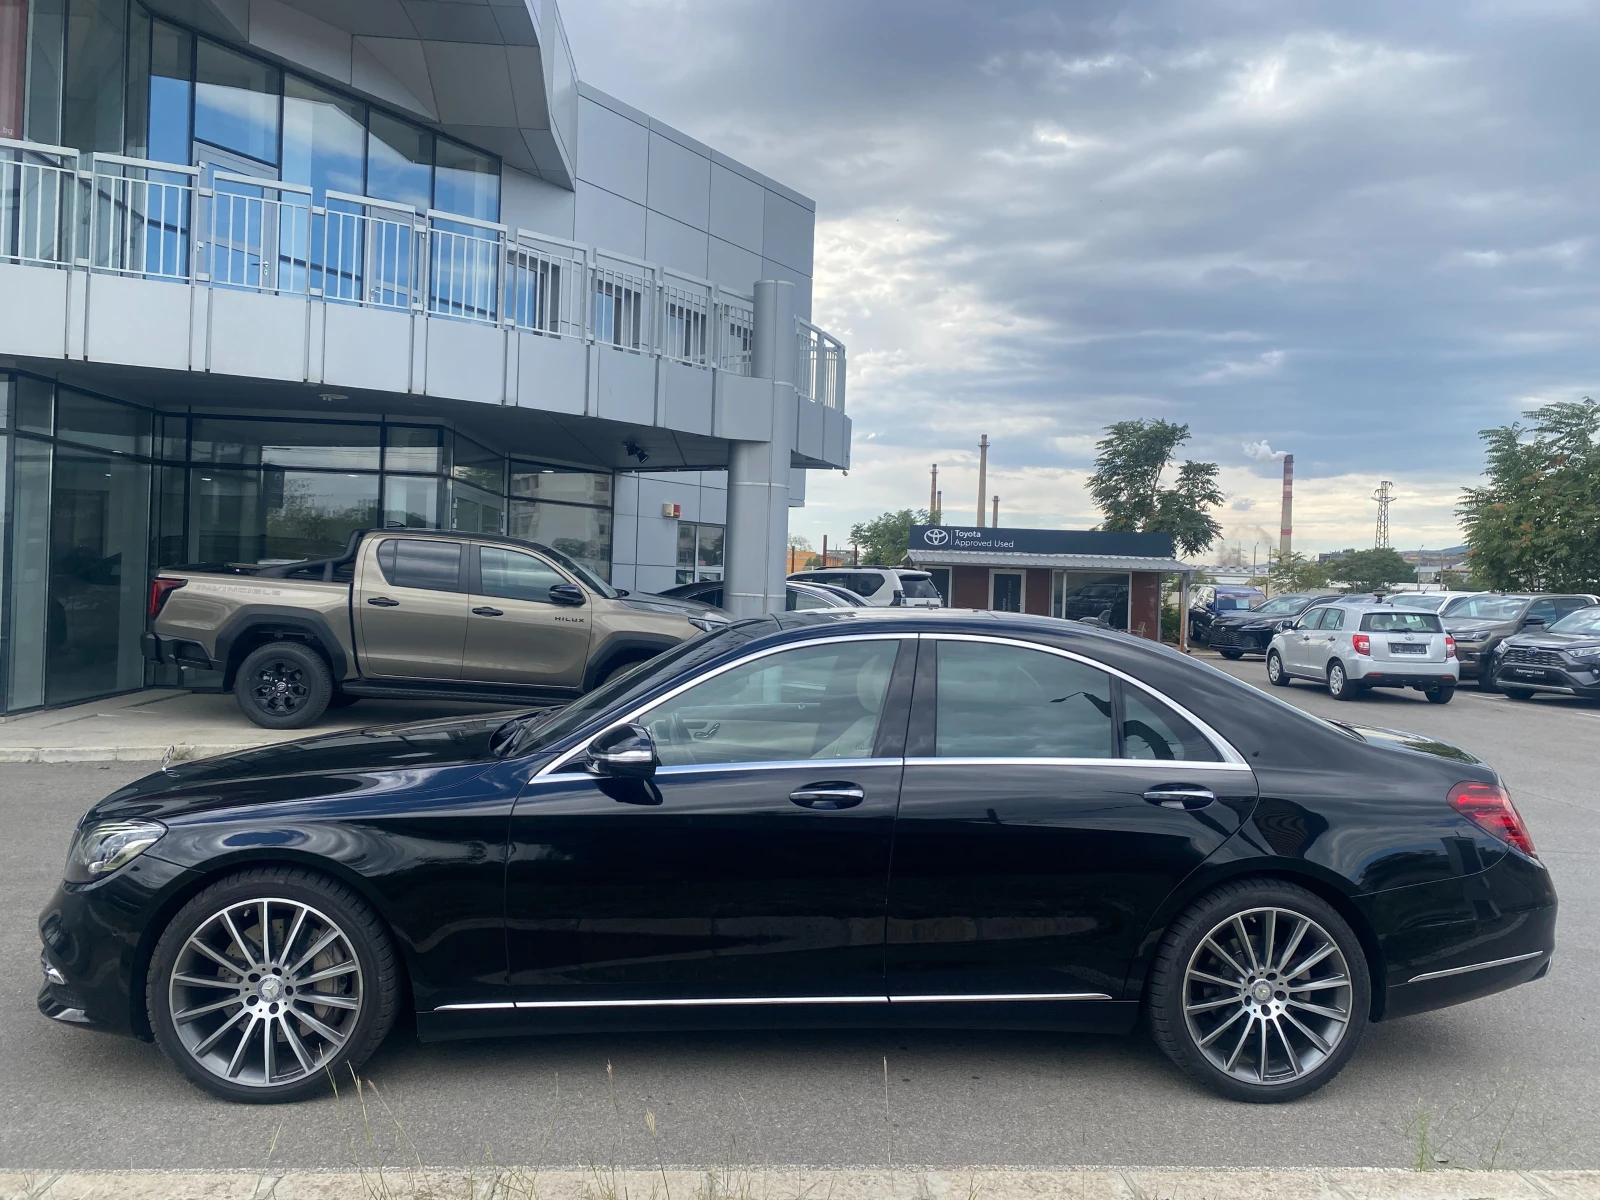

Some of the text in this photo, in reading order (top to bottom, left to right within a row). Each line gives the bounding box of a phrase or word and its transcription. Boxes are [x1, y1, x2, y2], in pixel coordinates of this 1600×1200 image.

[954, 529, 981, 538] Toyota
[954, 538, 1014, 548] Approved Used
